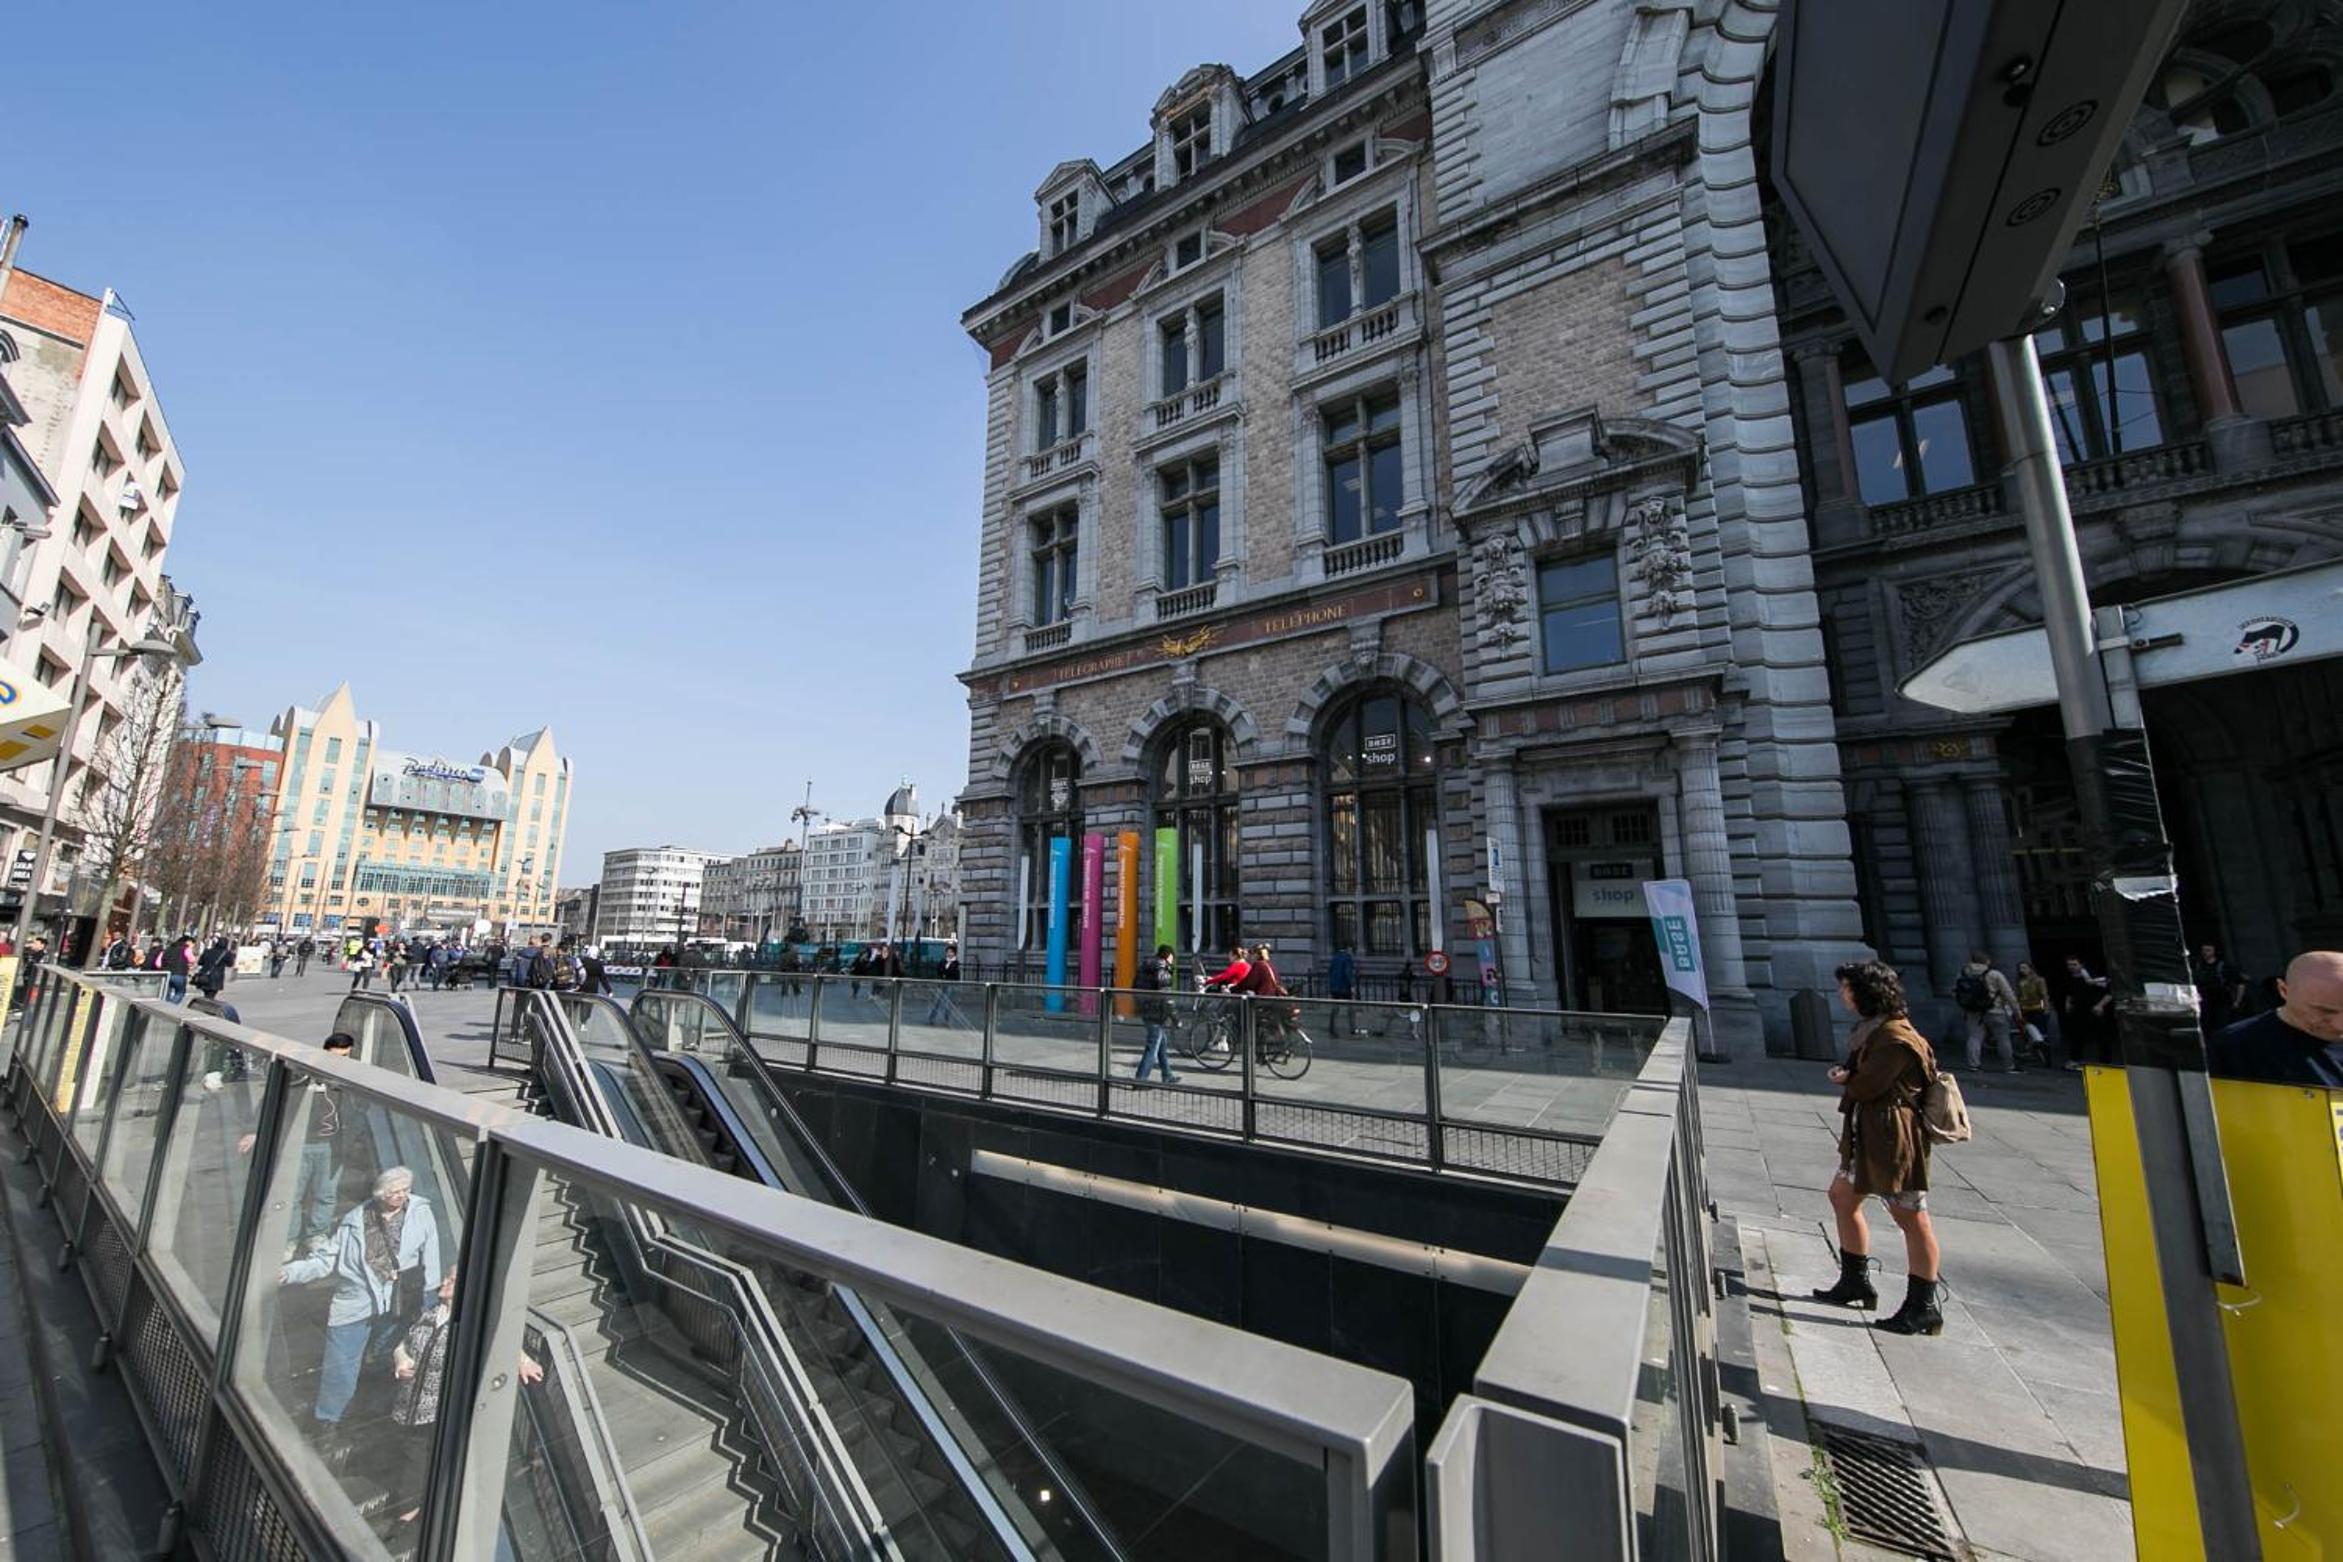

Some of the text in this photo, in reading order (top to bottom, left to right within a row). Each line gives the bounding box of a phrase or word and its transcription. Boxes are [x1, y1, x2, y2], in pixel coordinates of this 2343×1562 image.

[1263, 605, 1346, 633] TELEPHONE
[1366, 752, 1396, 765] shop
[1592, 888, 1634, 904] shop
